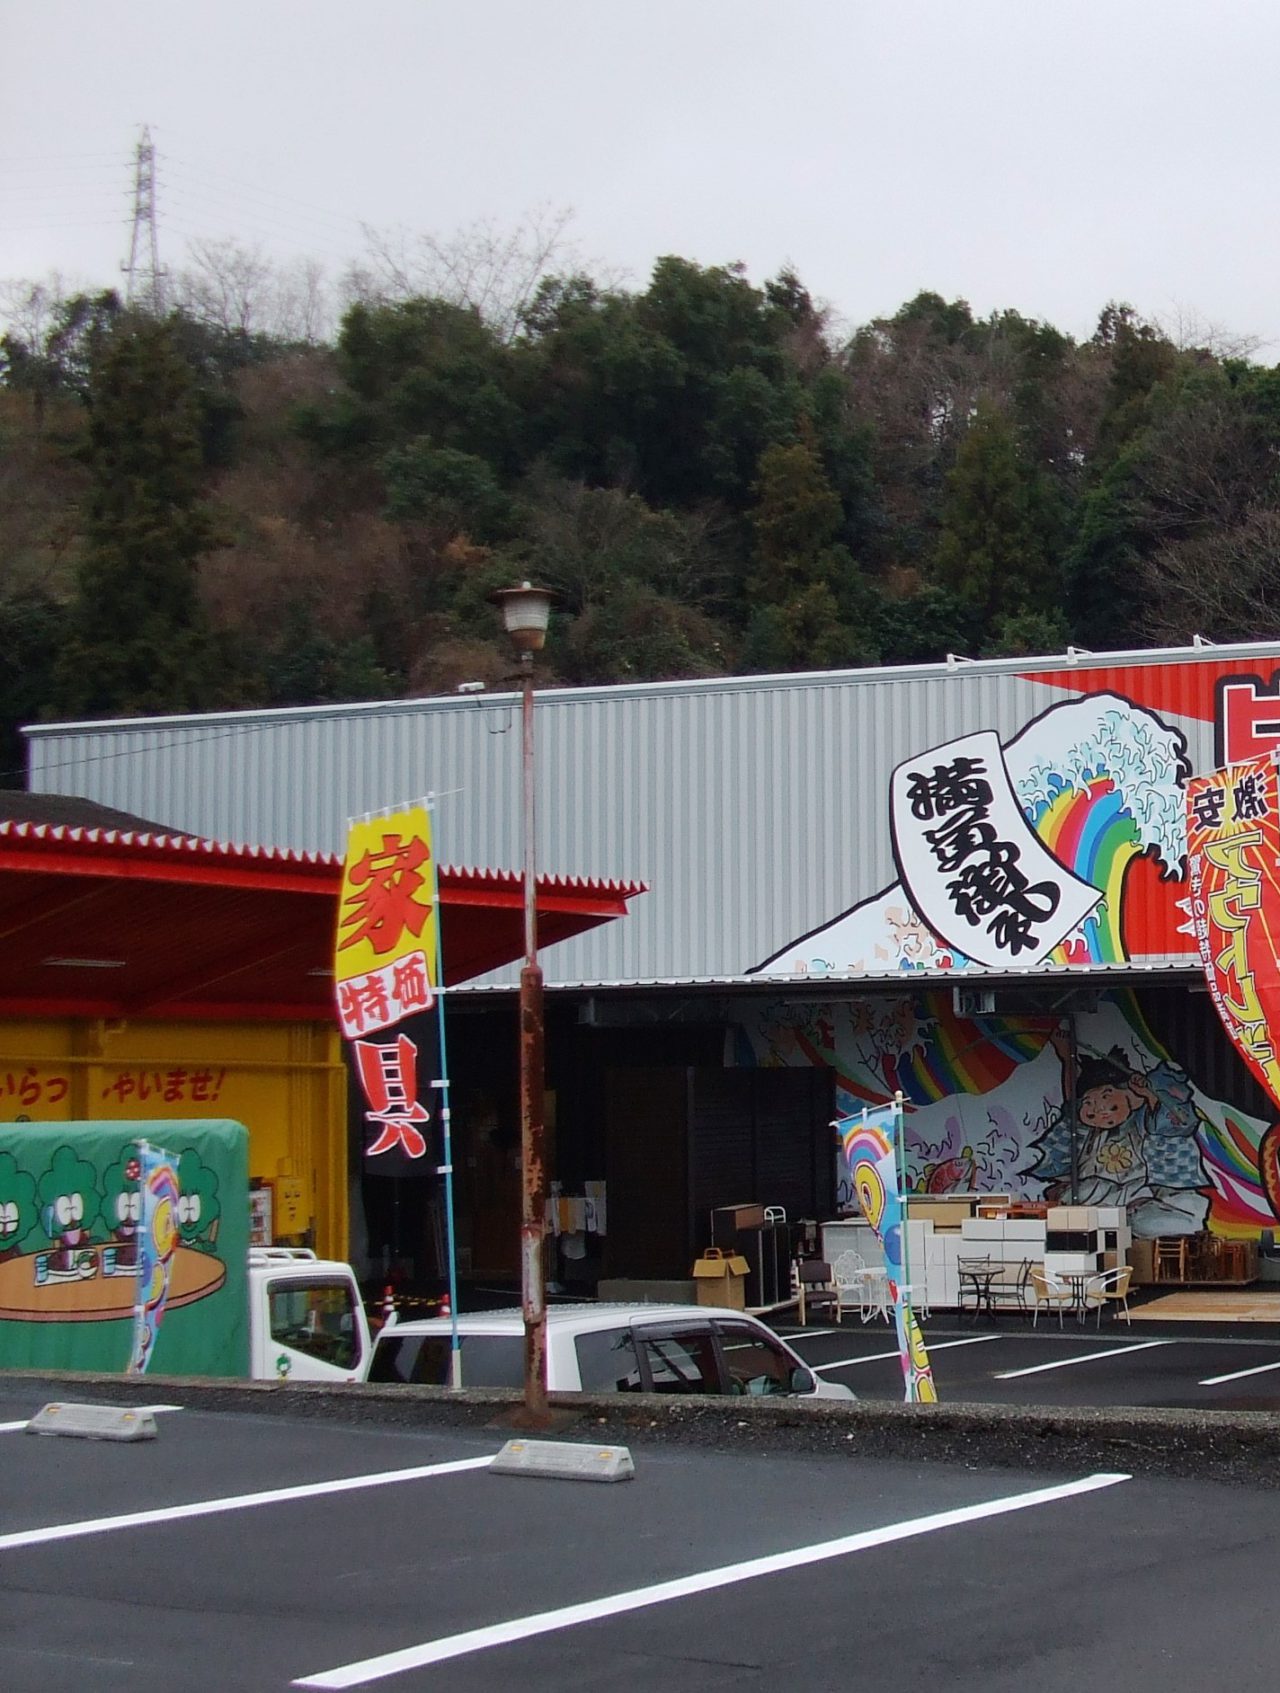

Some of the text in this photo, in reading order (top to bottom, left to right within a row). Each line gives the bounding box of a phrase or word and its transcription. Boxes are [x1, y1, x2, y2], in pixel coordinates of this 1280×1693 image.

[337, 834, 433, 955] 家
[340, 955, 430, 1031] 特価
[354, 1033, 430, 1159] 具
